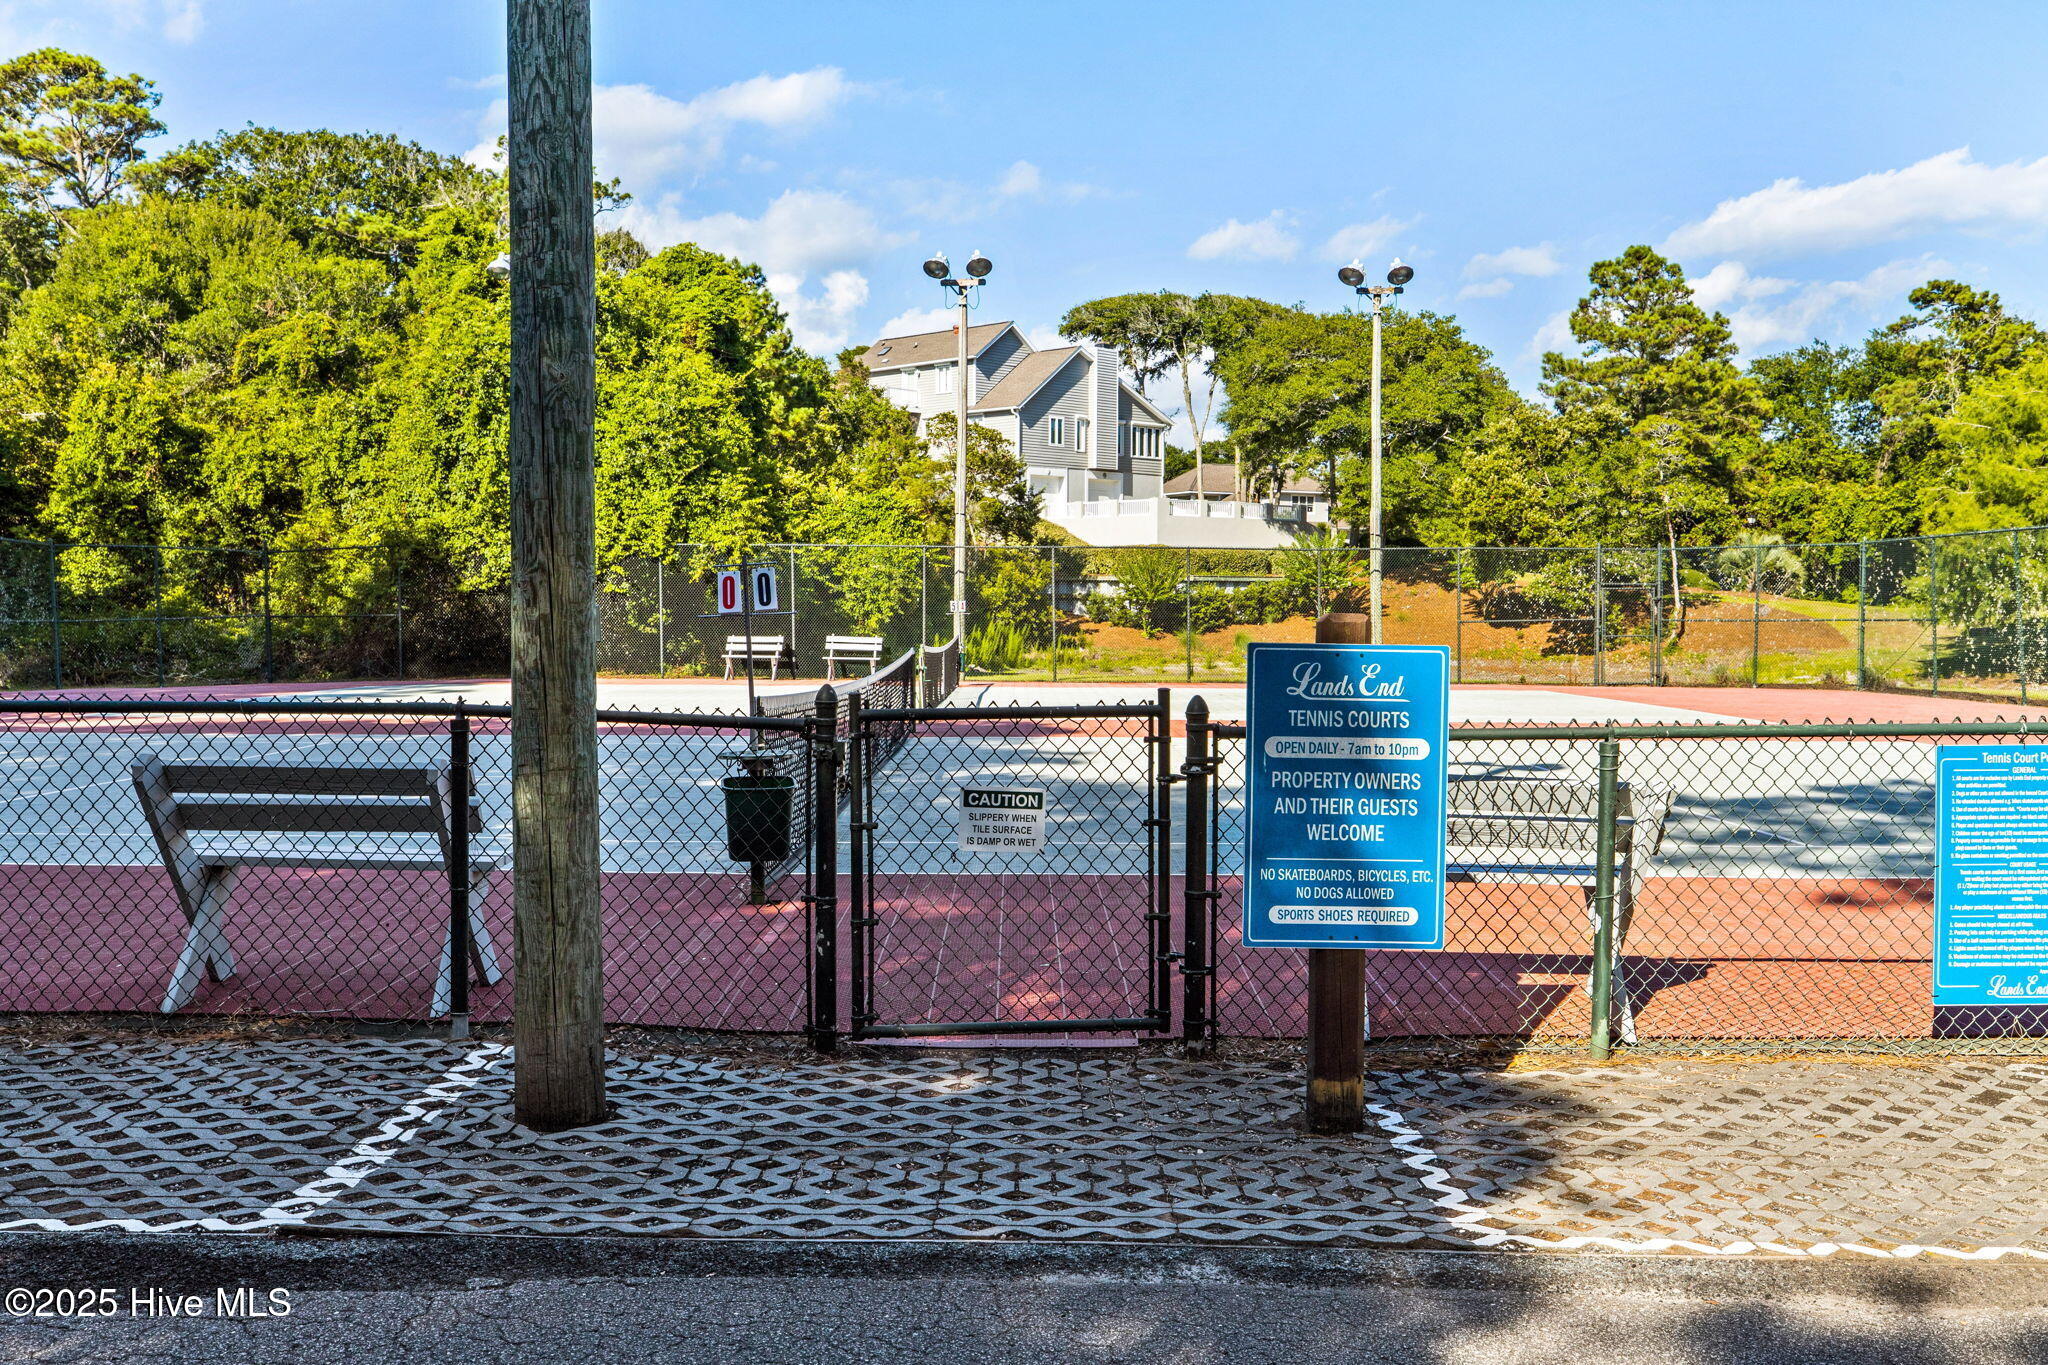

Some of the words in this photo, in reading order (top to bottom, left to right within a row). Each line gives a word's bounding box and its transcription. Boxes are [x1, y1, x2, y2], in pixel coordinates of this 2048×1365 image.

[723, 576, 735, 609] 0
[758, 573, 771, 606] 0
[1287, 662, 1354, 699] Lands
[1359, 663, 1404, 698] End
[1288, 710, 1343, 727] TENNIS
[1348, 710, 1410, 728] COURTS
[1276, 742, 1306, 754] OPEN
[1308, 742, 1339, 754] DAILY
[1348, 742, 1371, 755] 7am
[1374, 743, 1385, 755] to
[1389, 743, 1419, 757] 10pm
[1983, 753, 2011, 763] Tennis
[2014, 753, 2039, 763] Court
[1272, 771, 1351, 789] PROPERTY
[1355, 772, 1421, 790] OWNERS
[968, 792, 1038, 807] CAUTION
[1274, 798, 1306, 814] AND
[1311, 798, 1353, 815] THEIR
[1358, 799, 1418, 816] GUESTS
[969, 813, 1009, 822] SLIPPERY
[973, 825, 990, 833] TILE
[993, 825, 1032, 834] SURFACE
[1307, 825, 1384, 841] WELCOME
[977, 837, 1001, 845] DAMP
[1004, 838, 1015, 846] OR
[1260, 869, 1275, 880] NO
[1278, 869, 1355, 883] SKATEBOARDS,
[1358, 870, 1409, 883] BICYCLES,
[1412, 871, 1433, 882] ETC.
[1296, 887, 1311, 898] NO
[1314, 887, 1343, 899] DOGS
[1346, 888, 1394, 899] ALLOWED
[1277, 909, 1314, 920] SPORTS
[1319, 910, 1353, 921] SHOES
[1357, 911, 1409, 923] REQUIRED
[1986, 974, 2024, 996] Lands
